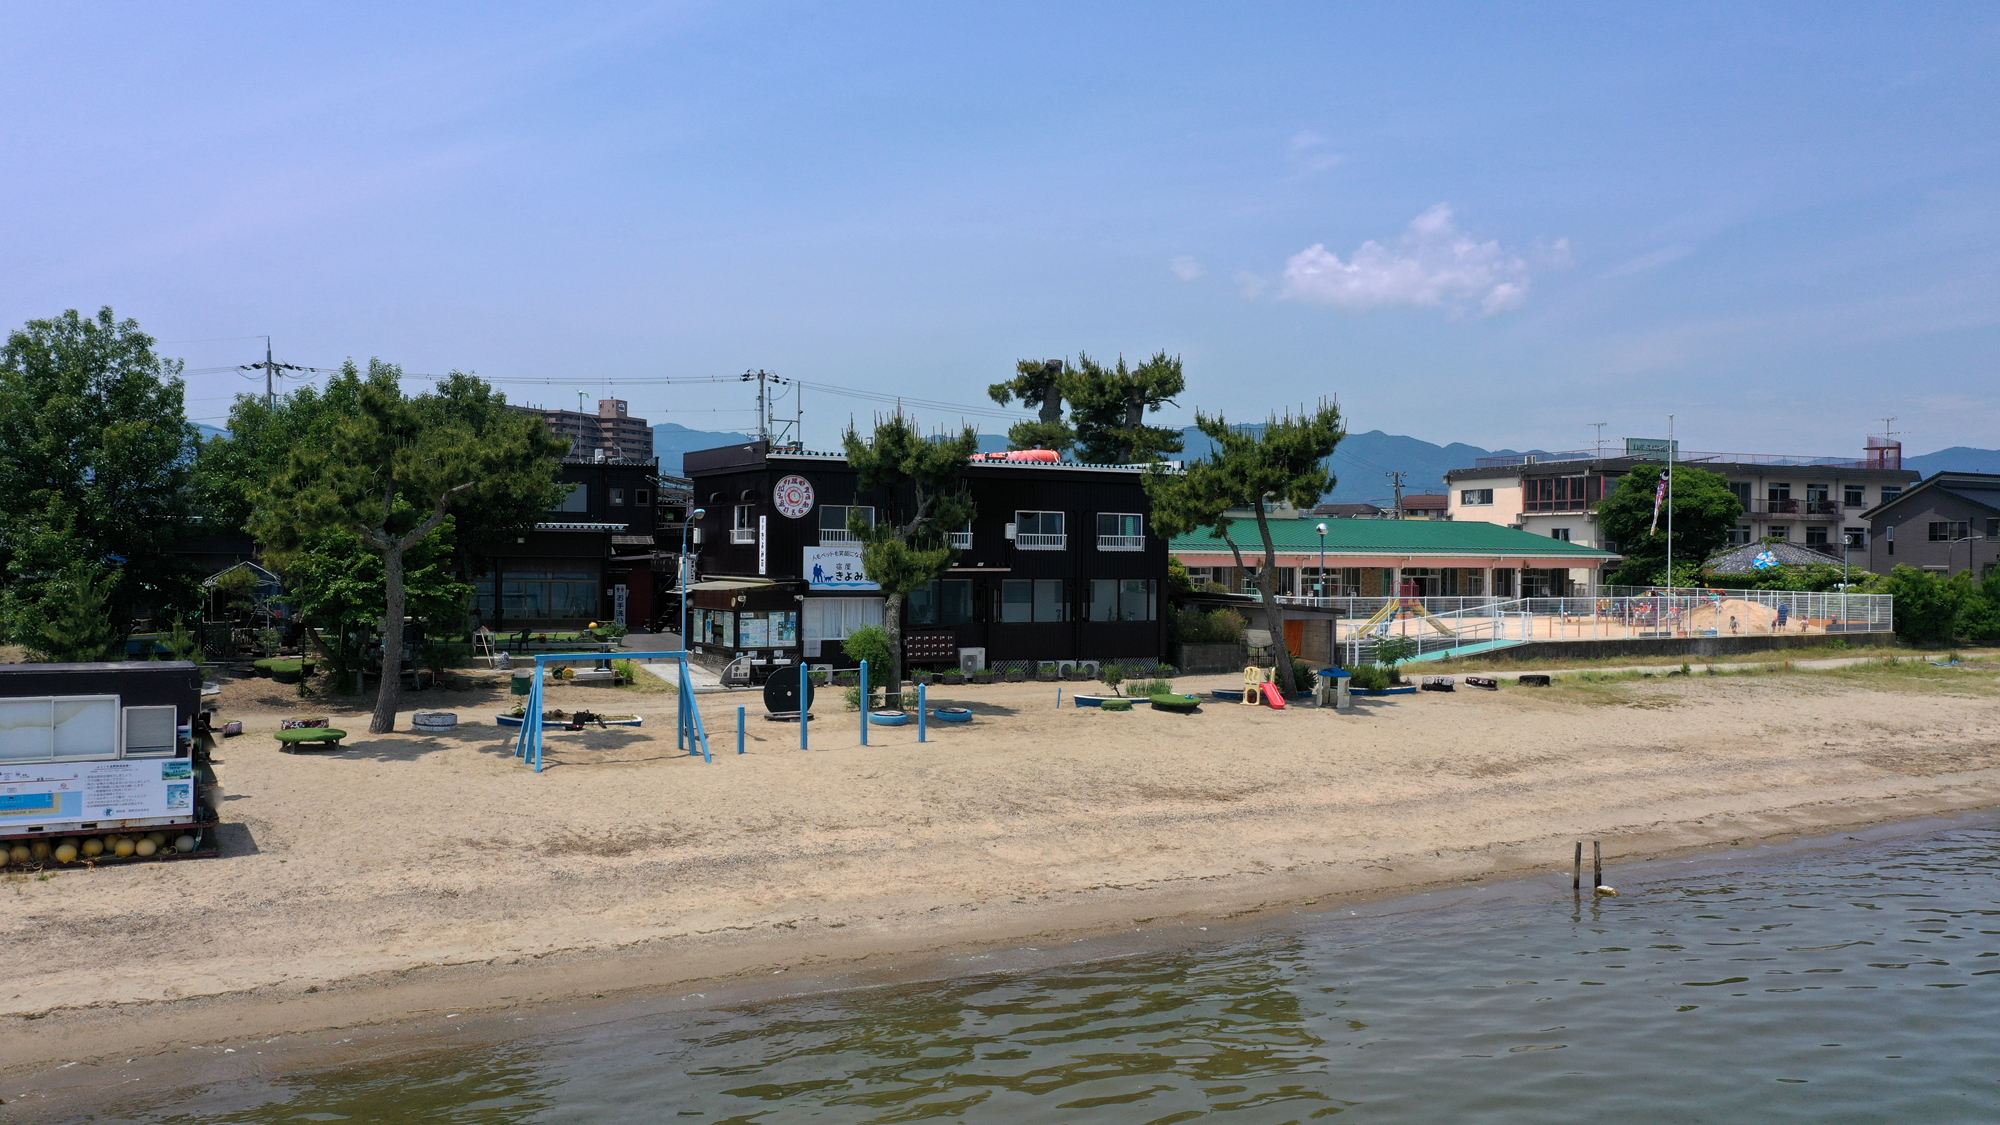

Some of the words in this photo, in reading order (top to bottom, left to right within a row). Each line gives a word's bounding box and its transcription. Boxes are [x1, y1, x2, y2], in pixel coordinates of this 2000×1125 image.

[835, 571, 868, 582] きよみ
[615, 594, 625, 624] お手洗い
